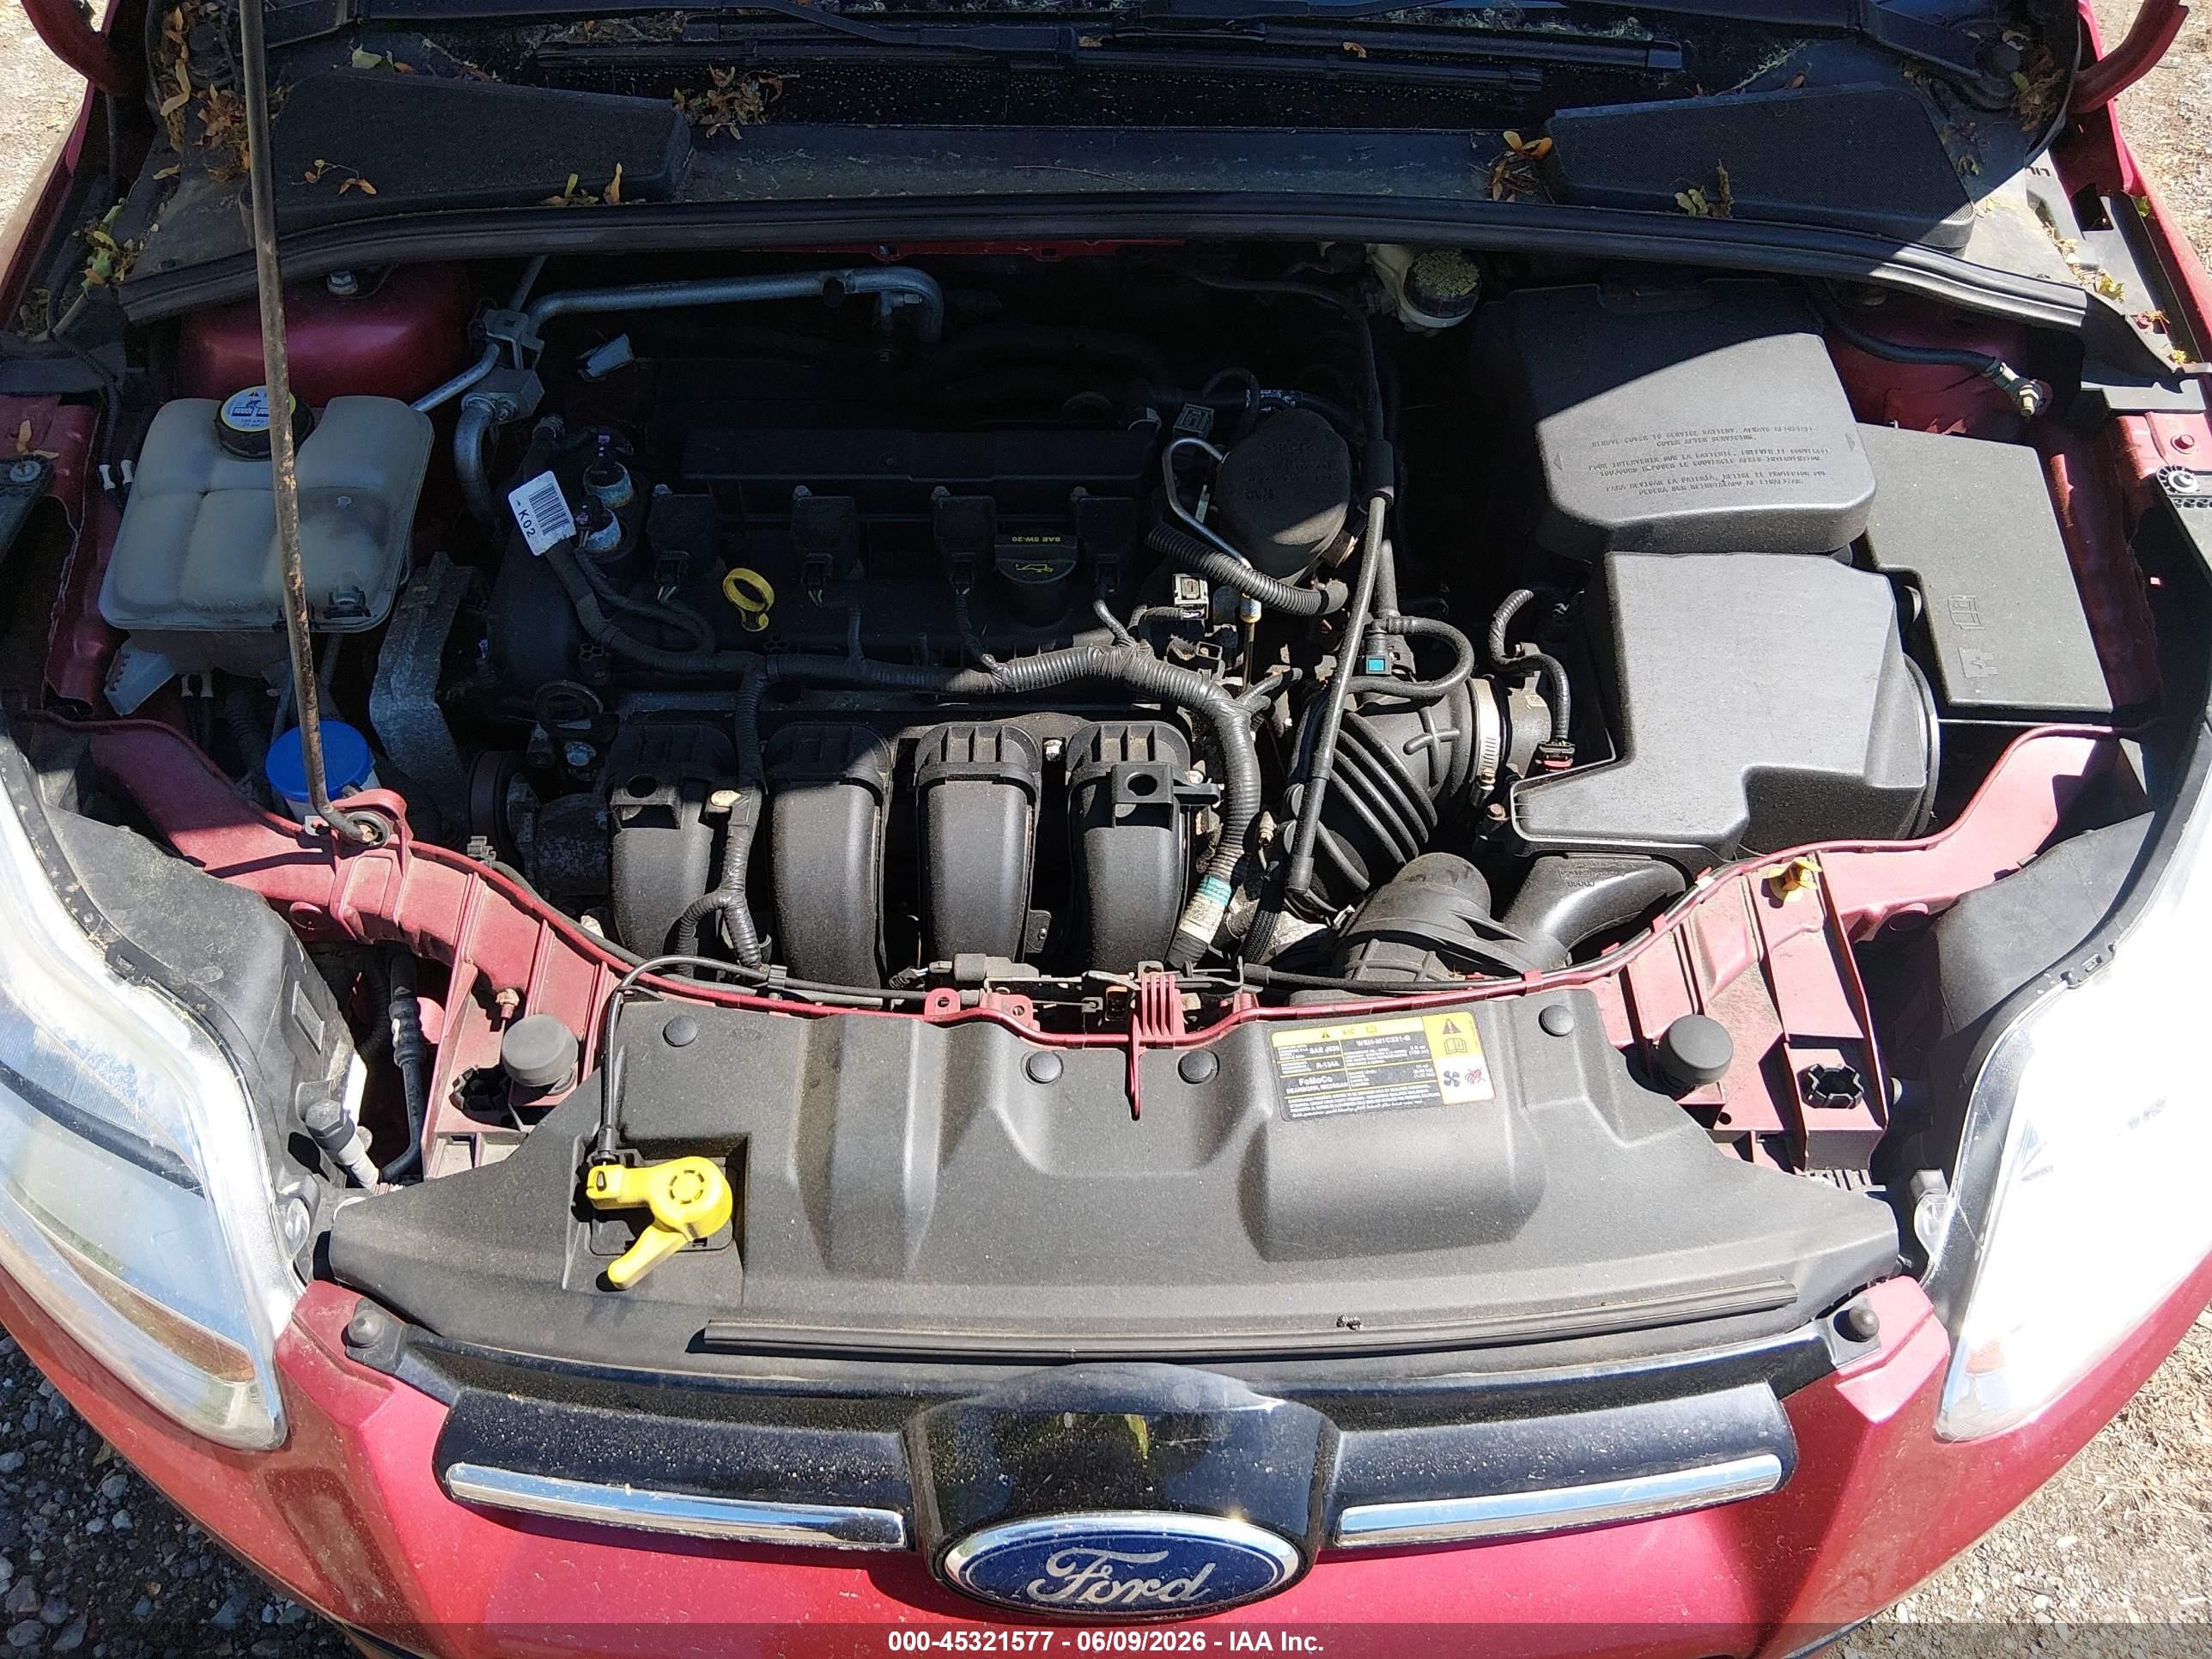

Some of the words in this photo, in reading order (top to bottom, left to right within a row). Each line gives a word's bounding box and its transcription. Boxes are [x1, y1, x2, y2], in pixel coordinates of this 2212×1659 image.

[518, 508, 536, 538] K02
[1298, 1075, 1334, 1086] FoMoCo
[1027, 1547, 1216, 1605] Ford
